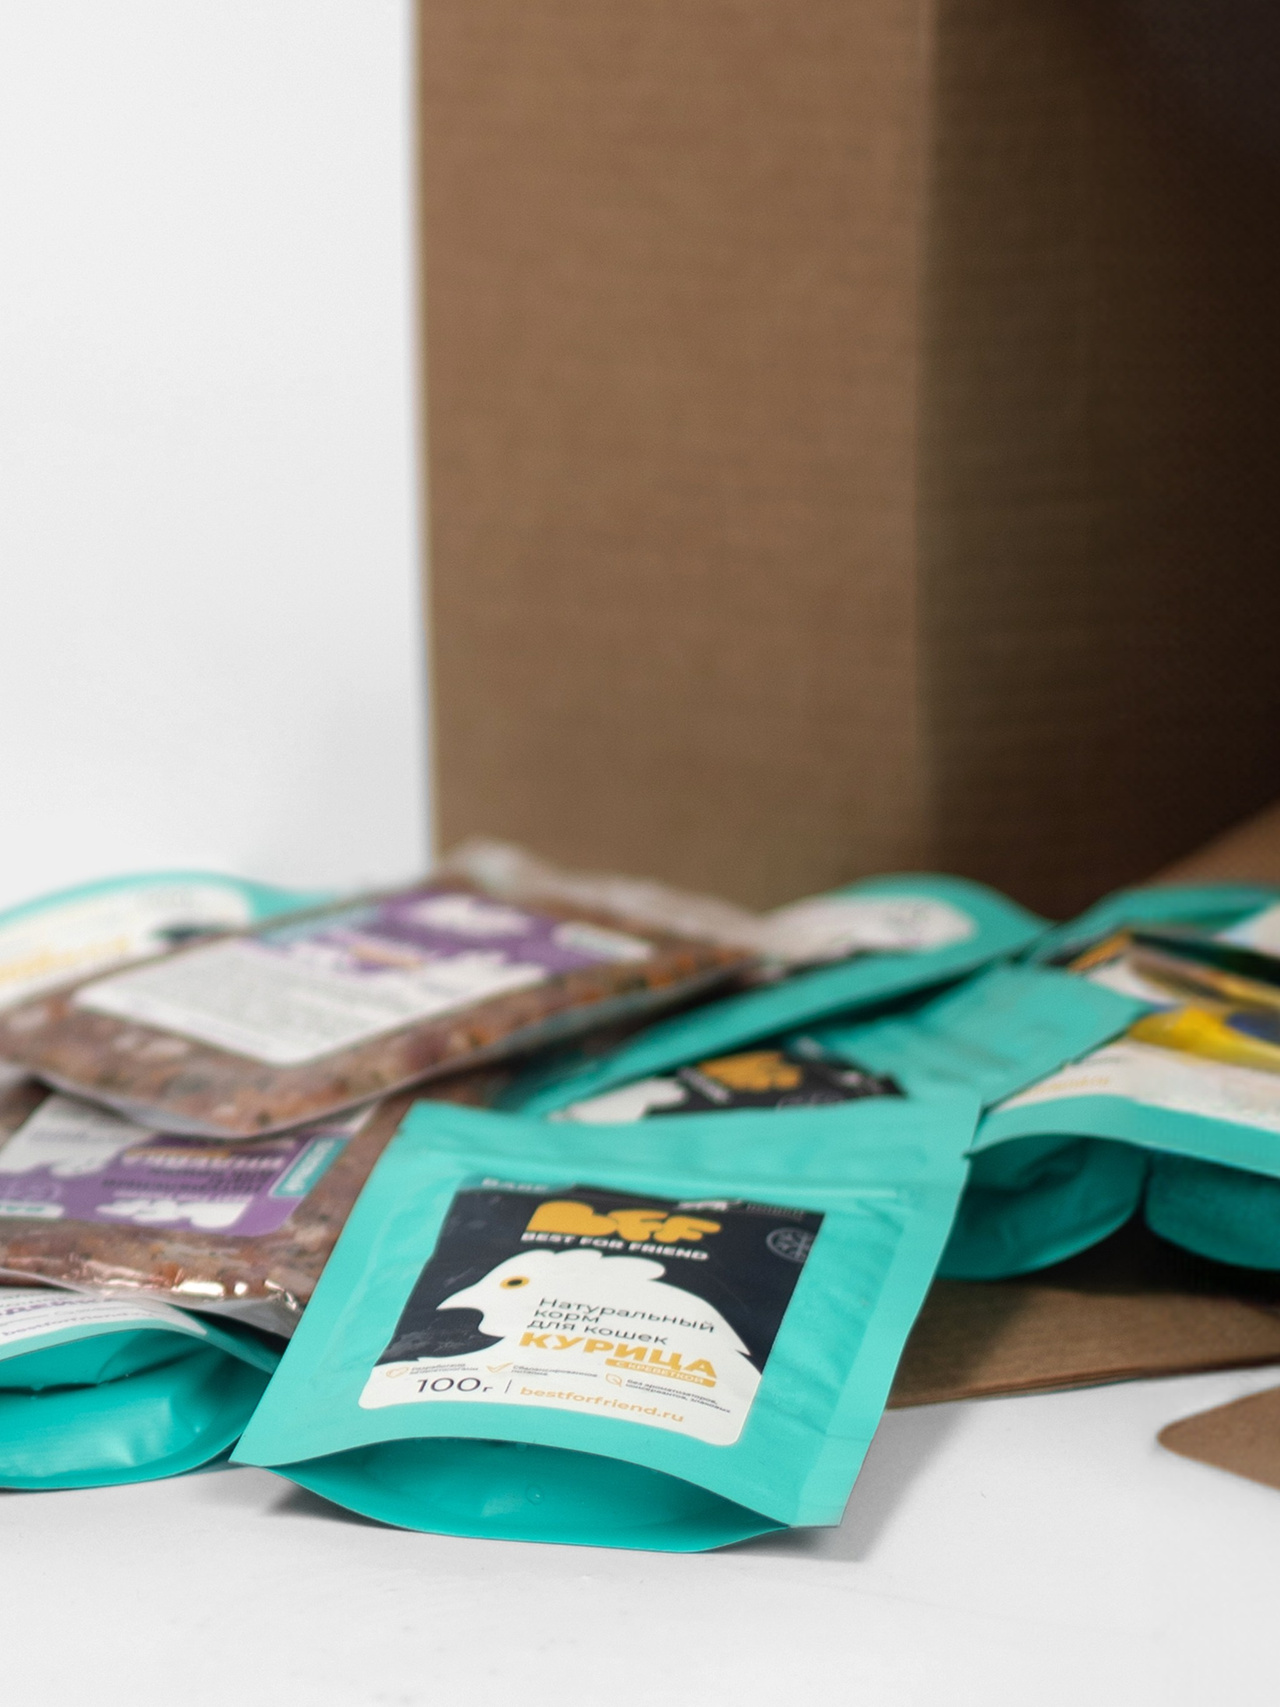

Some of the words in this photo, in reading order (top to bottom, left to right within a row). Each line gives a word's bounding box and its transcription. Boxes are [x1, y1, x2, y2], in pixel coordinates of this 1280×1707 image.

[521, 1232, 575, 1244] BEST
[580, 1236, 623, 1250] FOR
[628, 1240, 709, 1261] FRIEND
[533, 1309, 600, 1324] корм
[539, 1297, 715, 1333] Натуральный
[527, 1319, 575, 1331] для
[584, 1326, 668, 1345] кошек
[519, 1331, 718, 1379] КУРИЦА
[519, 1386, 685, 1423] bestforfriend.ru
